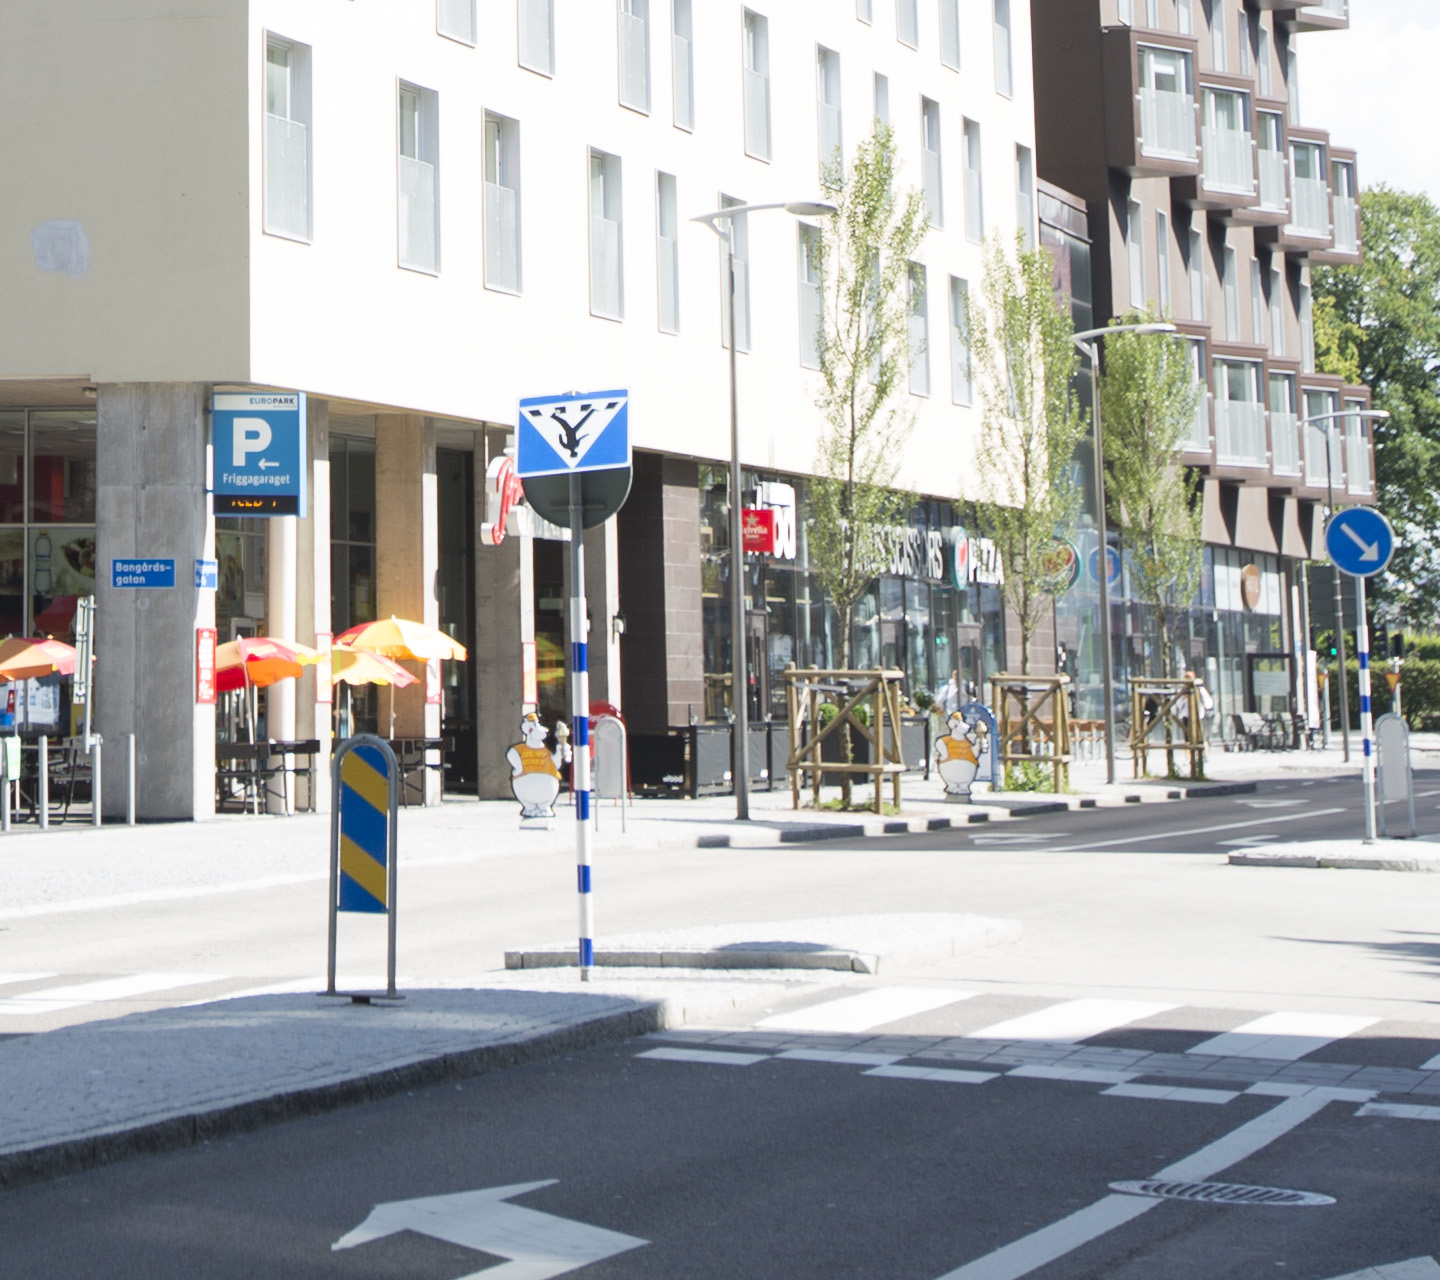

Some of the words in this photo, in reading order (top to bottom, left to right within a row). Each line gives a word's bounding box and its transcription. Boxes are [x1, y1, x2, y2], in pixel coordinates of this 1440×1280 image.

[249, 397, 295, 406] EUROPARK
[232, 417, 273, 467] P
[223, 472, 291, 487] Friggagaraget
[116, 562, 172, 574] Bangårds-
[116, 575, 146, 586] gatan
